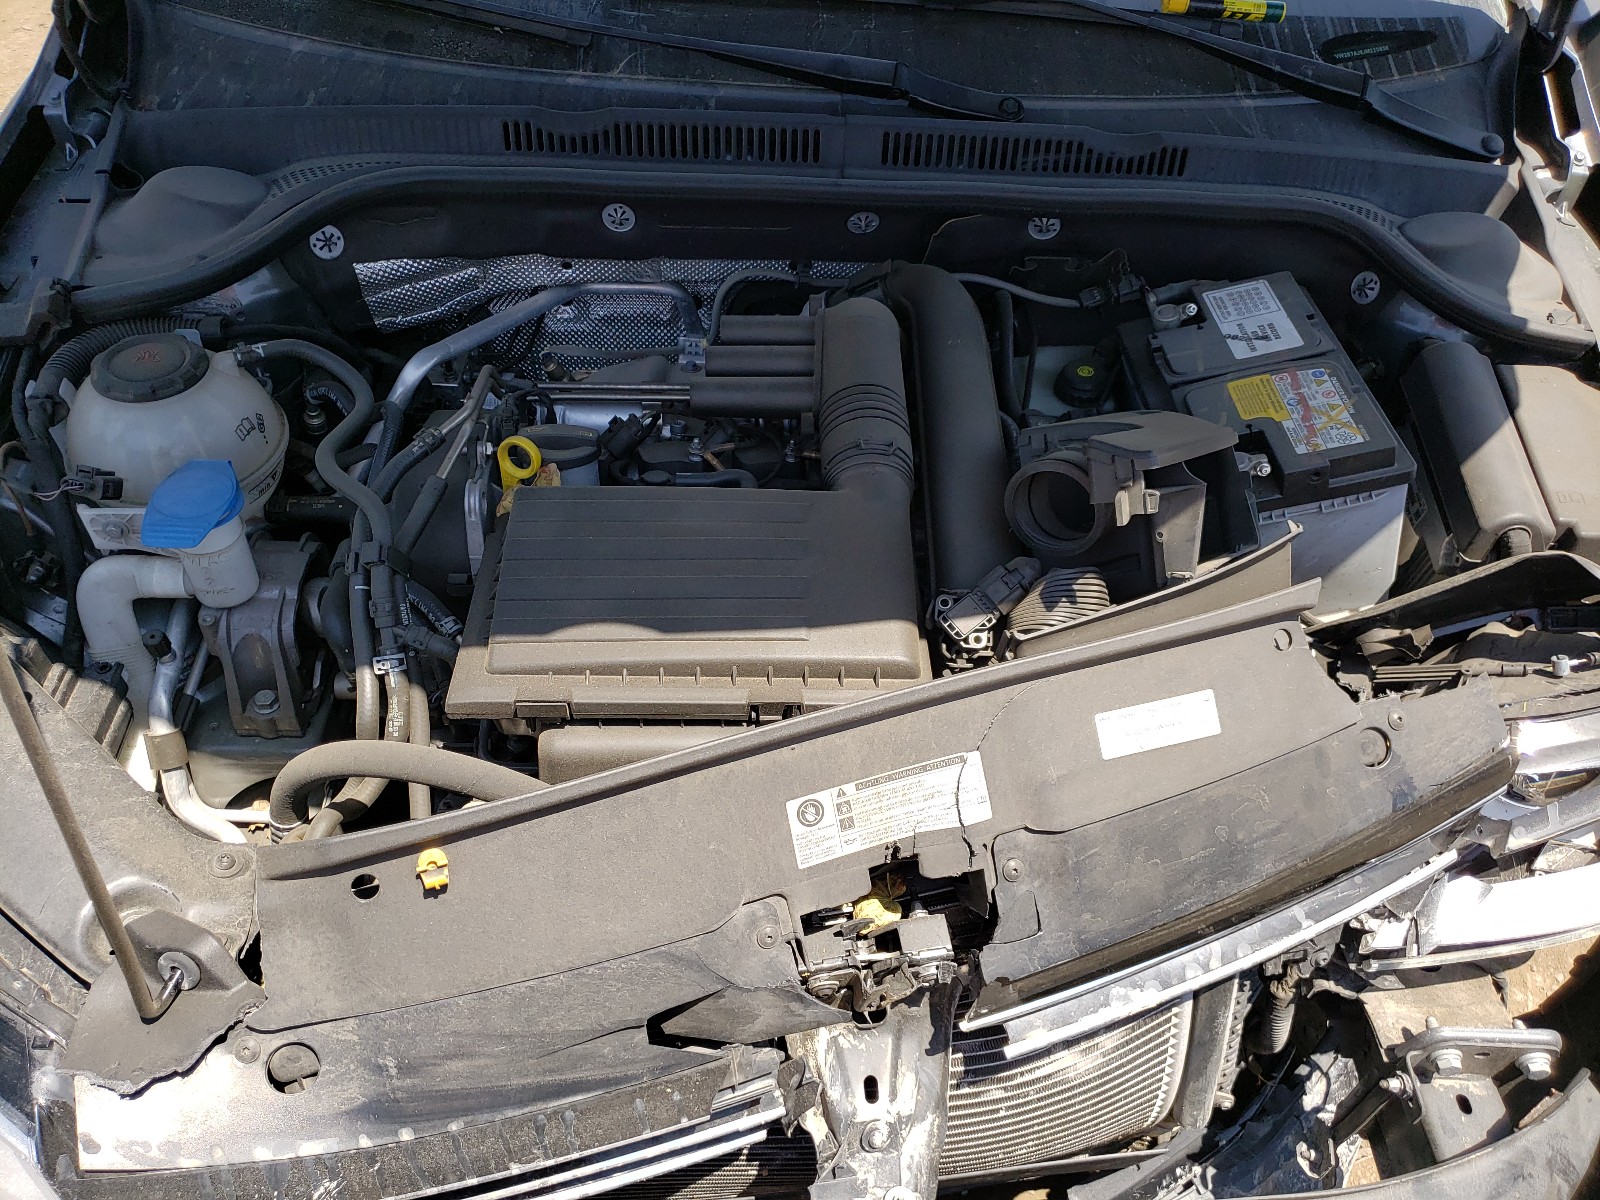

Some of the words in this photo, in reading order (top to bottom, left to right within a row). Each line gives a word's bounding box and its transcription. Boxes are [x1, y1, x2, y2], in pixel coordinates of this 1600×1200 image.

[258, 482, 271, 497] min
[857, 774, 890, 790] ACHTUNG
[892, 766, 924, 780] WARNING
[925, 756, 962, 772] ATTENTION
